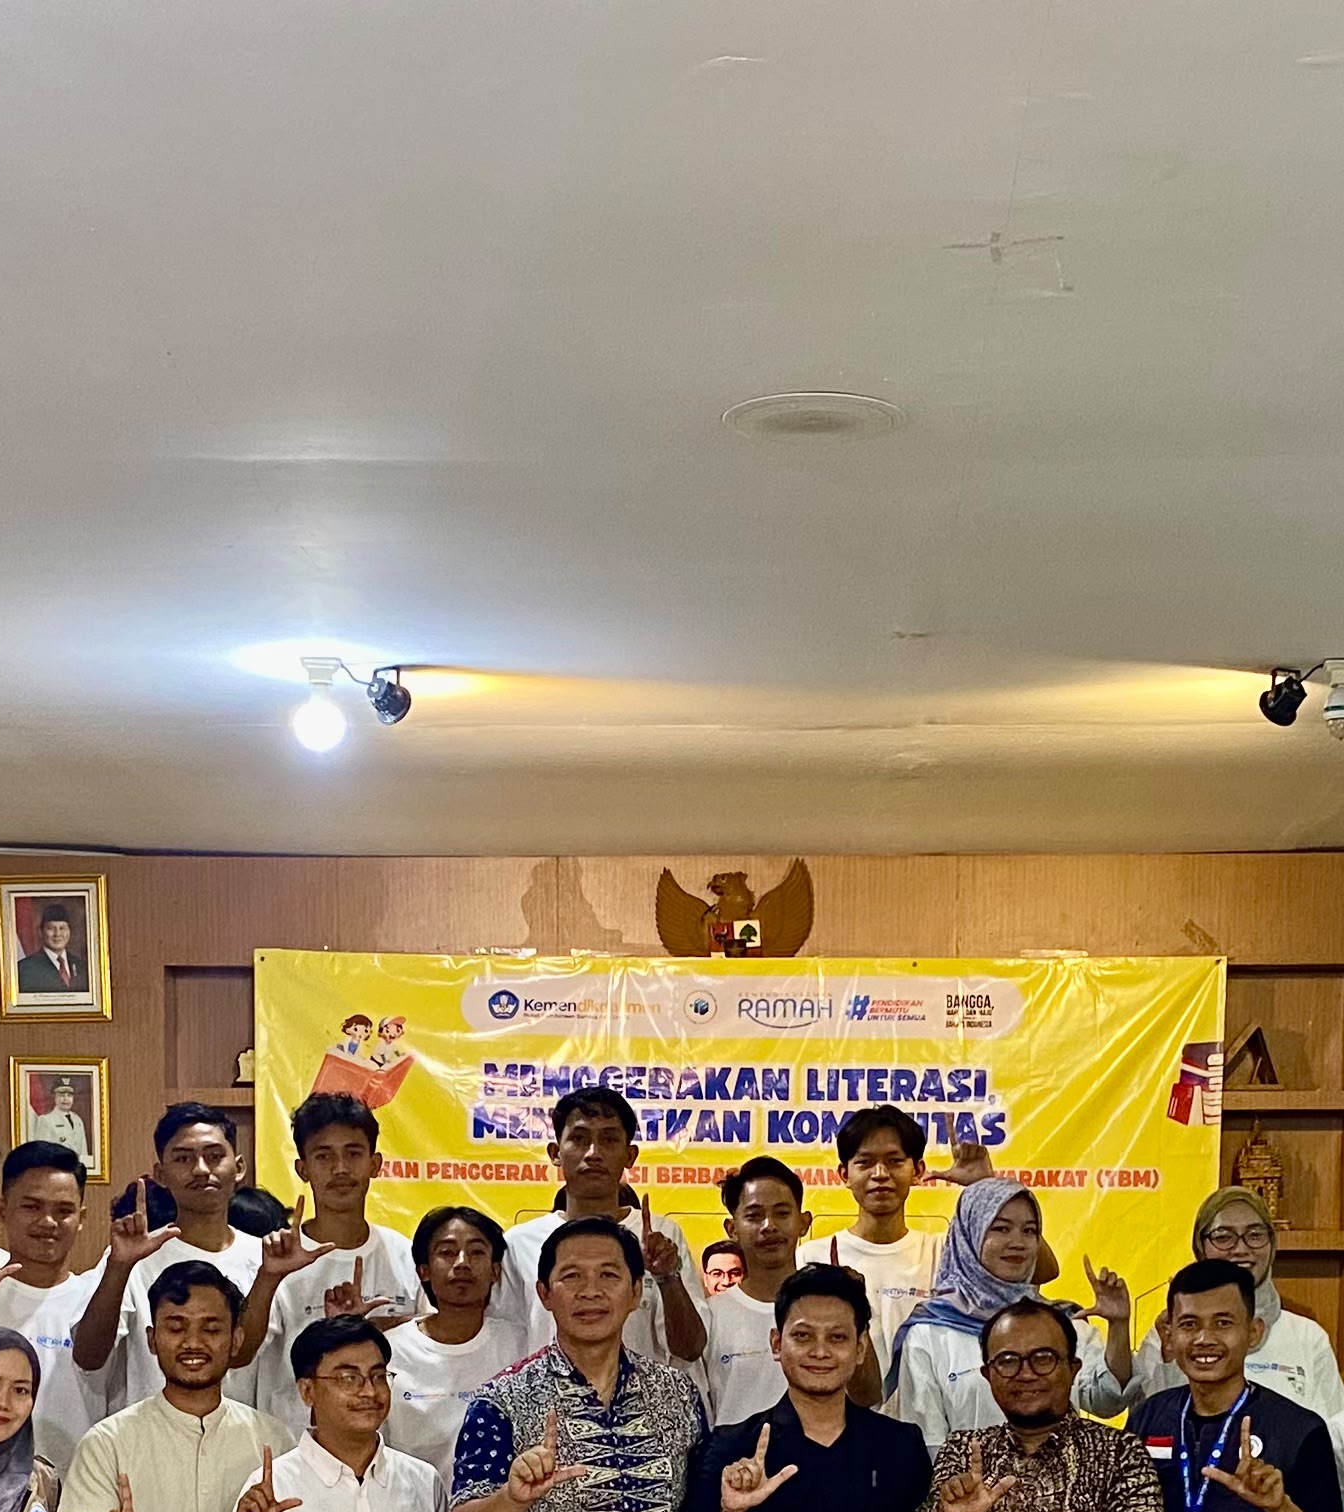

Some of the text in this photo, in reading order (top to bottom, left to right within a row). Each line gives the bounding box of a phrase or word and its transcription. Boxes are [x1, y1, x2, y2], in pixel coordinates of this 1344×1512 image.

[738, 998, 832, 1028] RAMAH
[807, 1068, 996, 1105] LITERASI,
[427, 1162, 548, 1182] PENGGERAK
[1097, 1168, 1159, 1188] (TBM)
